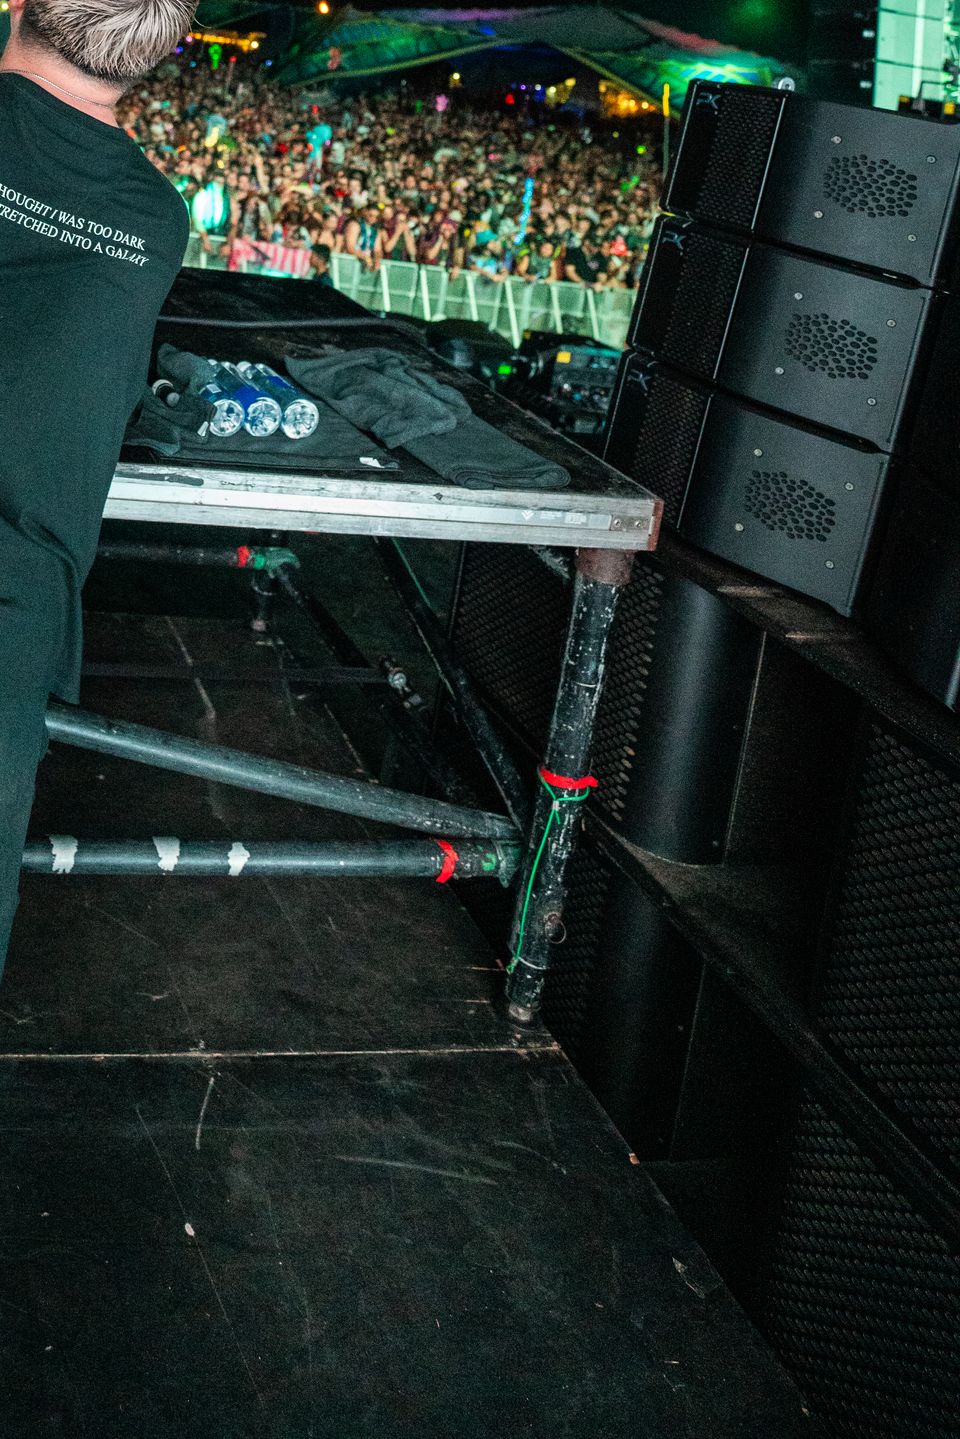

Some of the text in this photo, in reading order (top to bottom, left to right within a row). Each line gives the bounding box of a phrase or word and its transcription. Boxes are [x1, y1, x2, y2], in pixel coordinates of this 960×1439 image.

[49, 209, 59, 220] I
[58, 210, 86, 230] WAS
[87, 220, 113, 239] TOO
[113, 229, 146, 251] DARK
[59, 229, 92, 250] INTO
[93, 241, 104, 254] A
[105, 245, 150, 267] GALAXY
